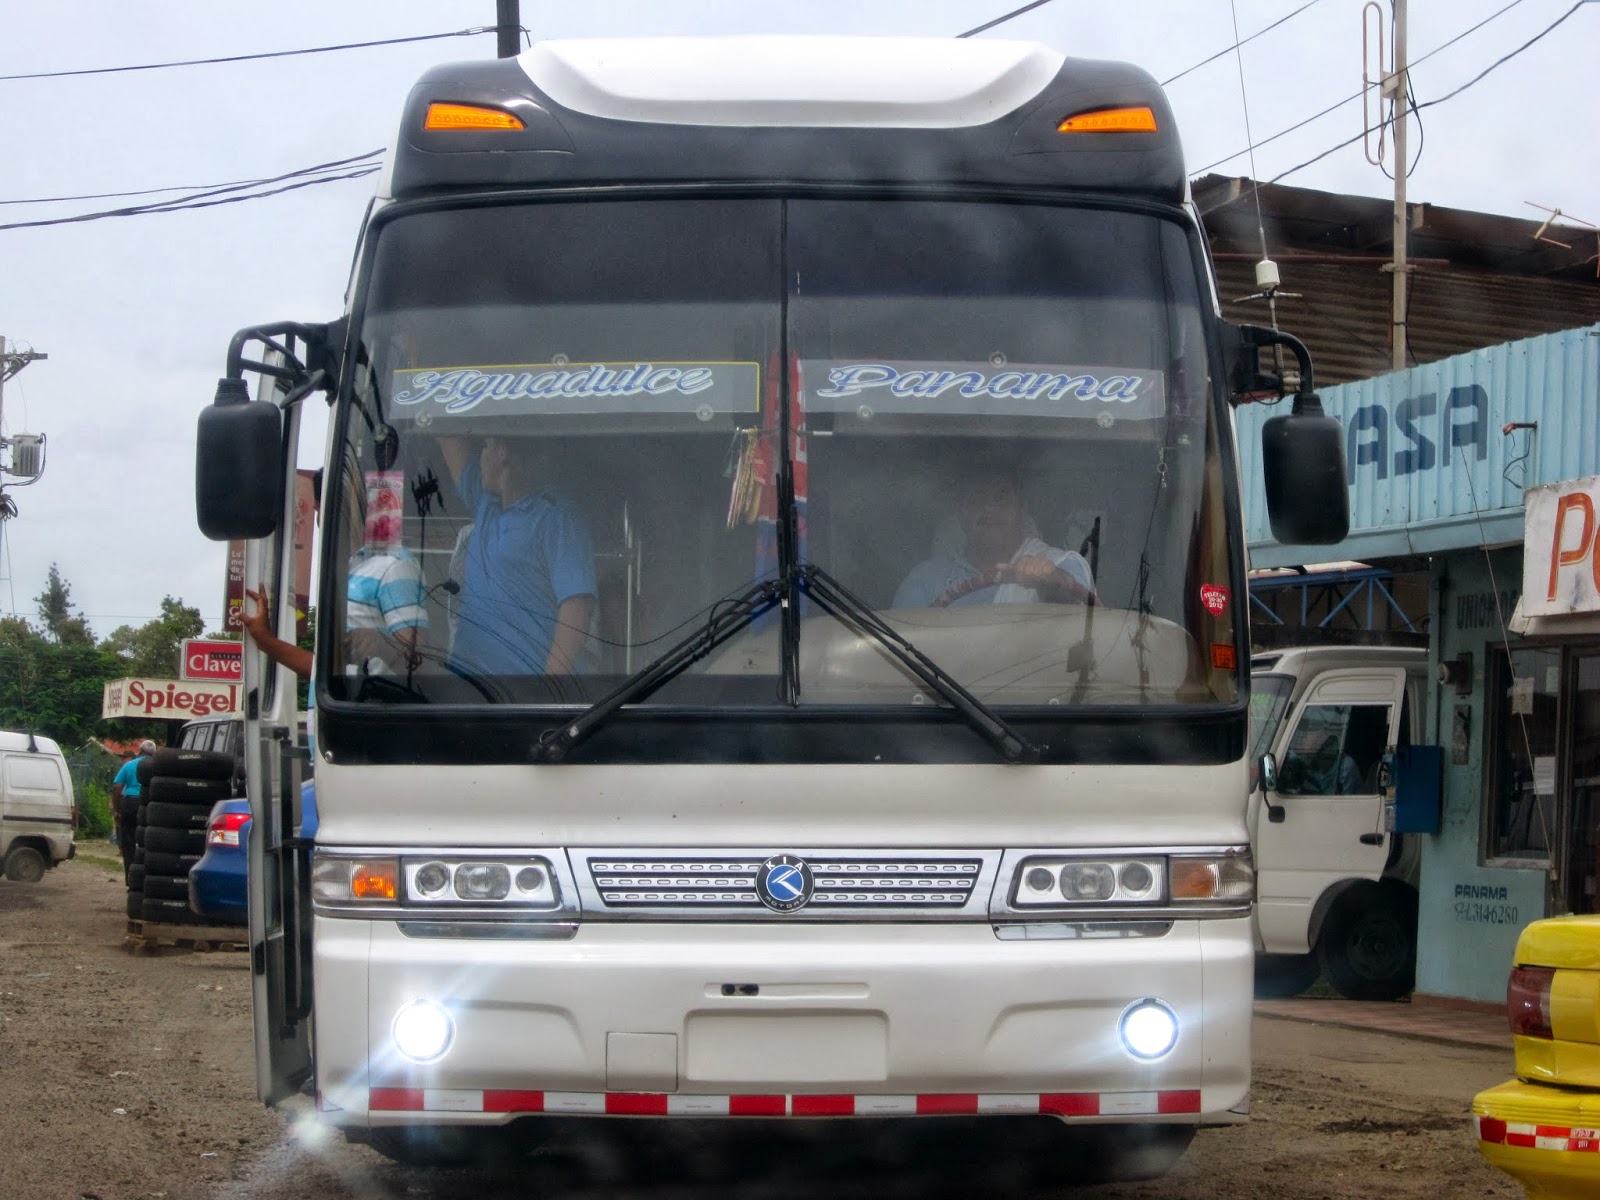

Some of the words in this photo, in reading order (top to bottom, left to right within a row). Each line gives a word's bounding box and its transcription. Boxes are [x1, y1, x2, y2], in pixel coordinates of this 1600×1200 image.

[394, 363, 713, 413] Aguadulce
[817, 364, 1142, 403] Panama
[1336, 384, 1488, 486] ASA
[189, 654, 241, 673] Clave
[128, 680, 236, 715] Spiegel
[765, 857, 803, 871] KIA
[1455, 884, 1507, 900] PANAMA
